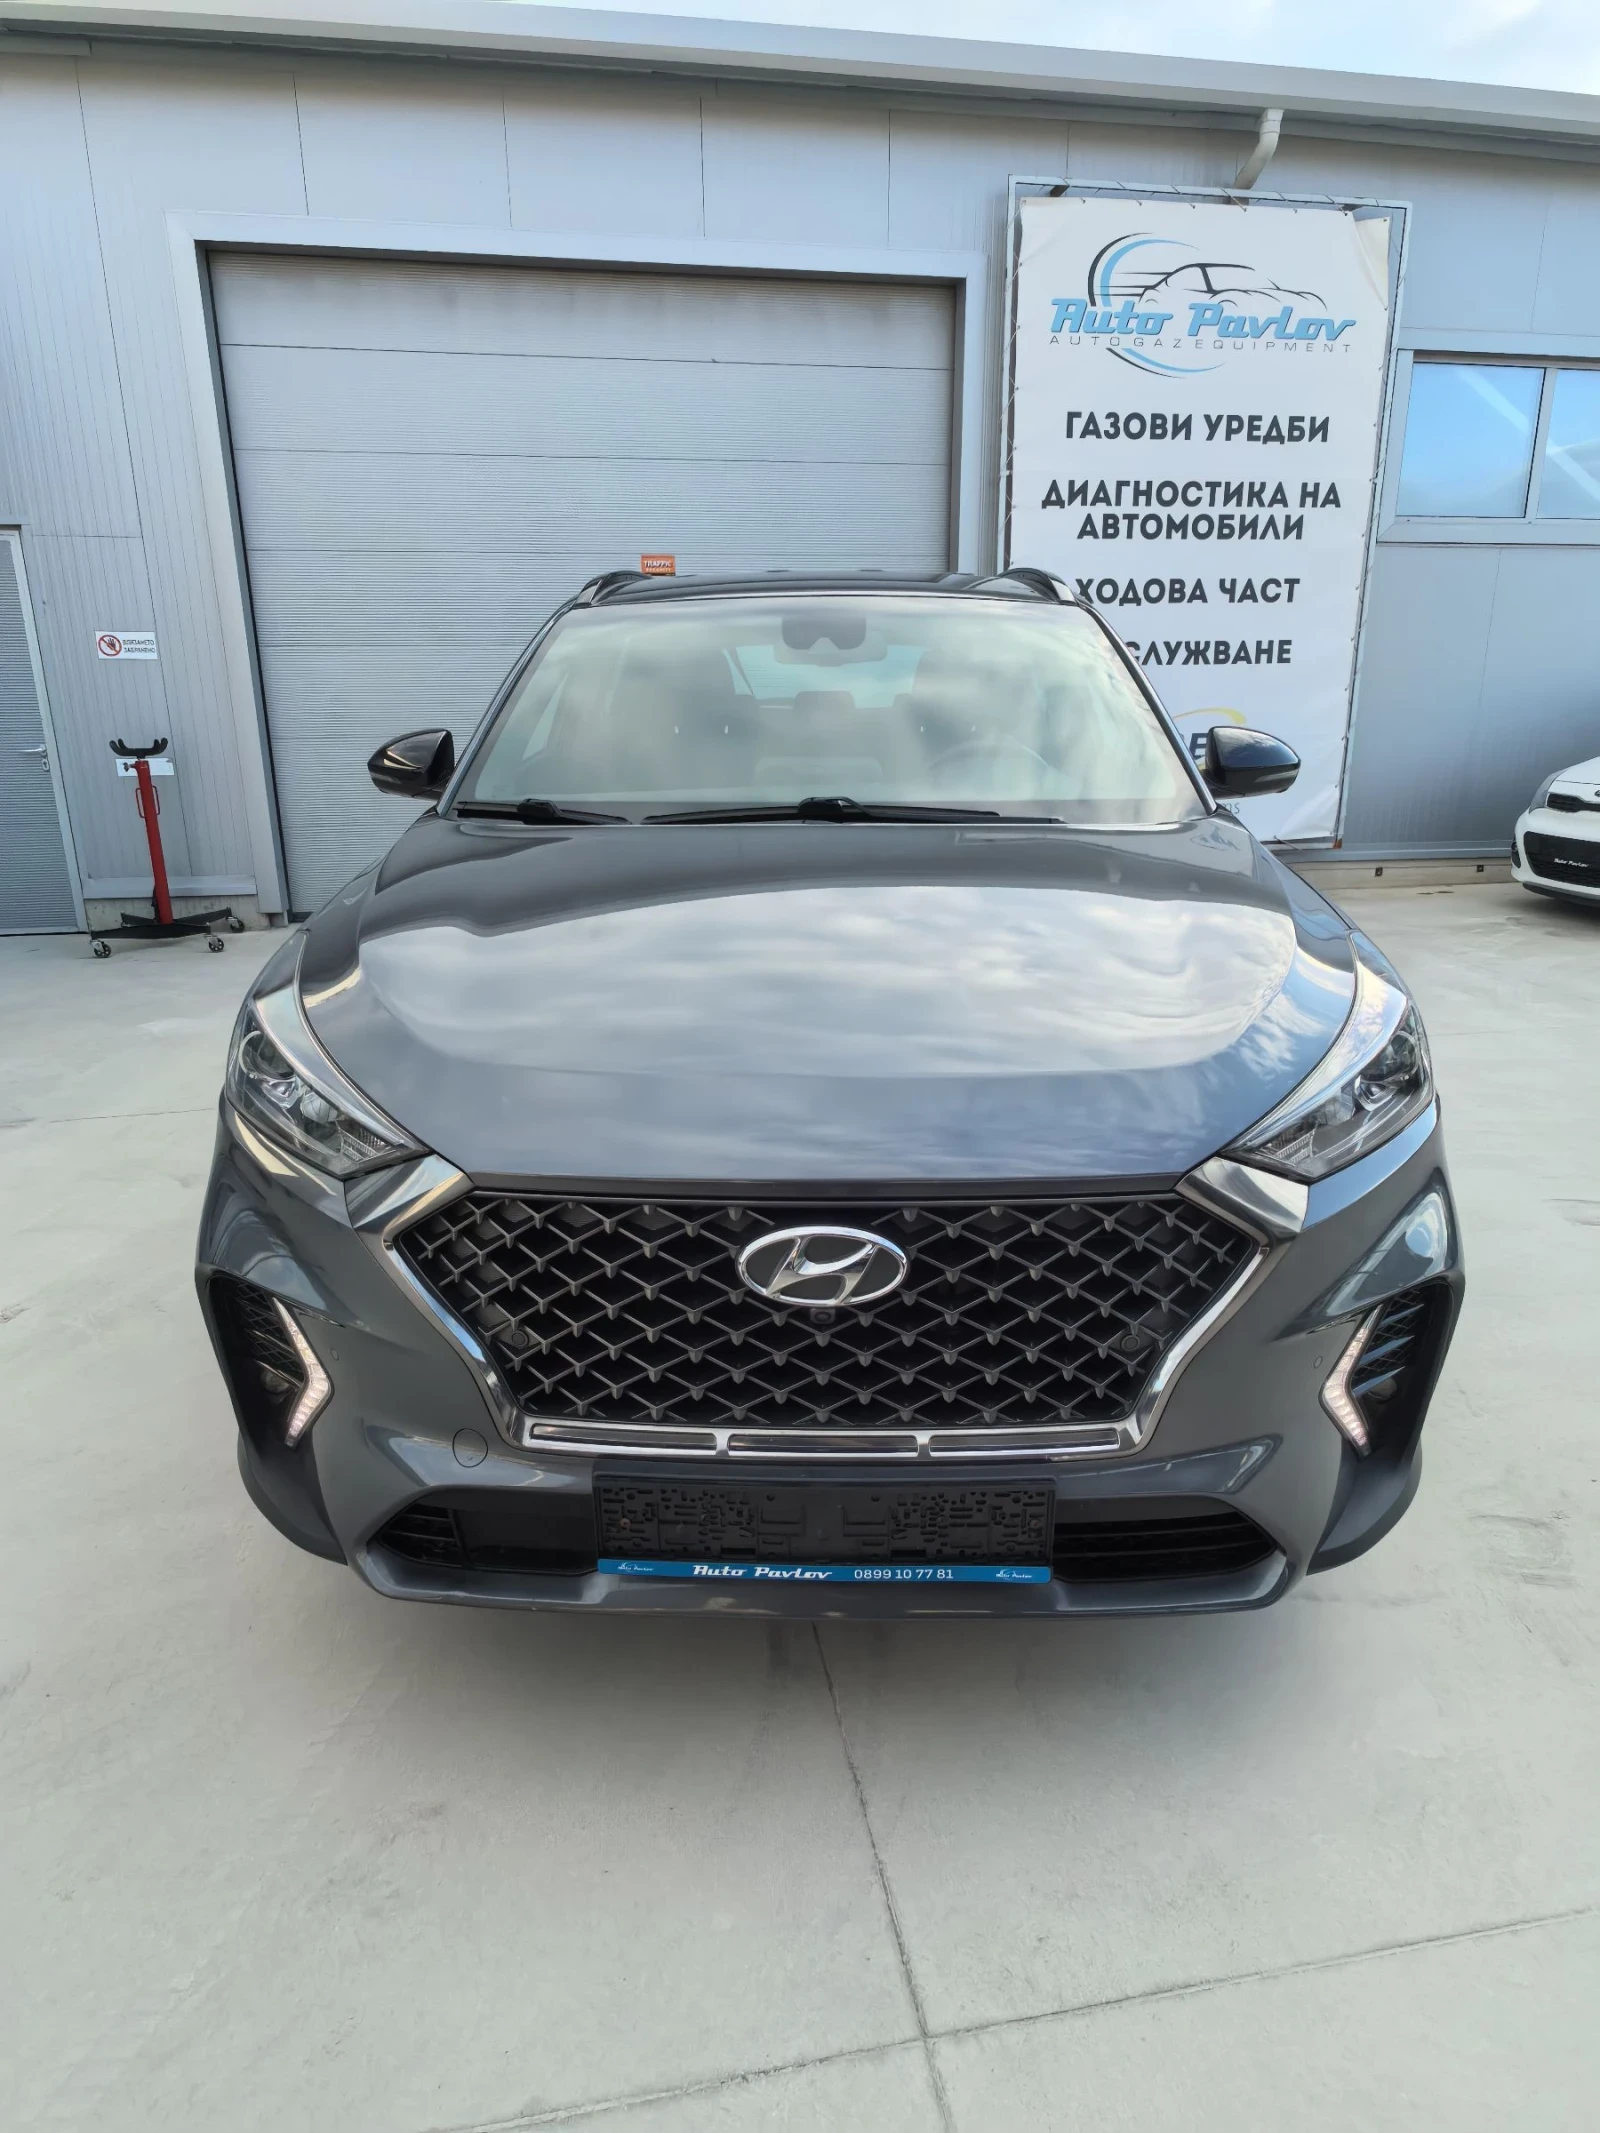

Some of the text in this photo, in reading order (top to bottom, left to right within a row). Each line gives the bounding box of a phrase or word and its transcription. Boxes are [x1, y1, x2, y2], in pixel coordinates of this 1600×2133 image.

[1050, 298, 1357, 342] Auto Pavlov
[1066, 411, 1330, 445] ГАЗОВИ УРЕДБИ
[1041, 479, 1341, 510] ДИАГНОСТИКА НА
[1076, 513, 1304, 541] АВТОМОБИЛИ
[1075, 577, 1301, 607] ХОДОВА ЧАСТ
[1124, 639, 1293, 666] СЛУЖВАНЕ
[692, 1564, 833, 1580] Auto Pavlov
[853, 1569, 954, 1580] 0899 10 77 81
